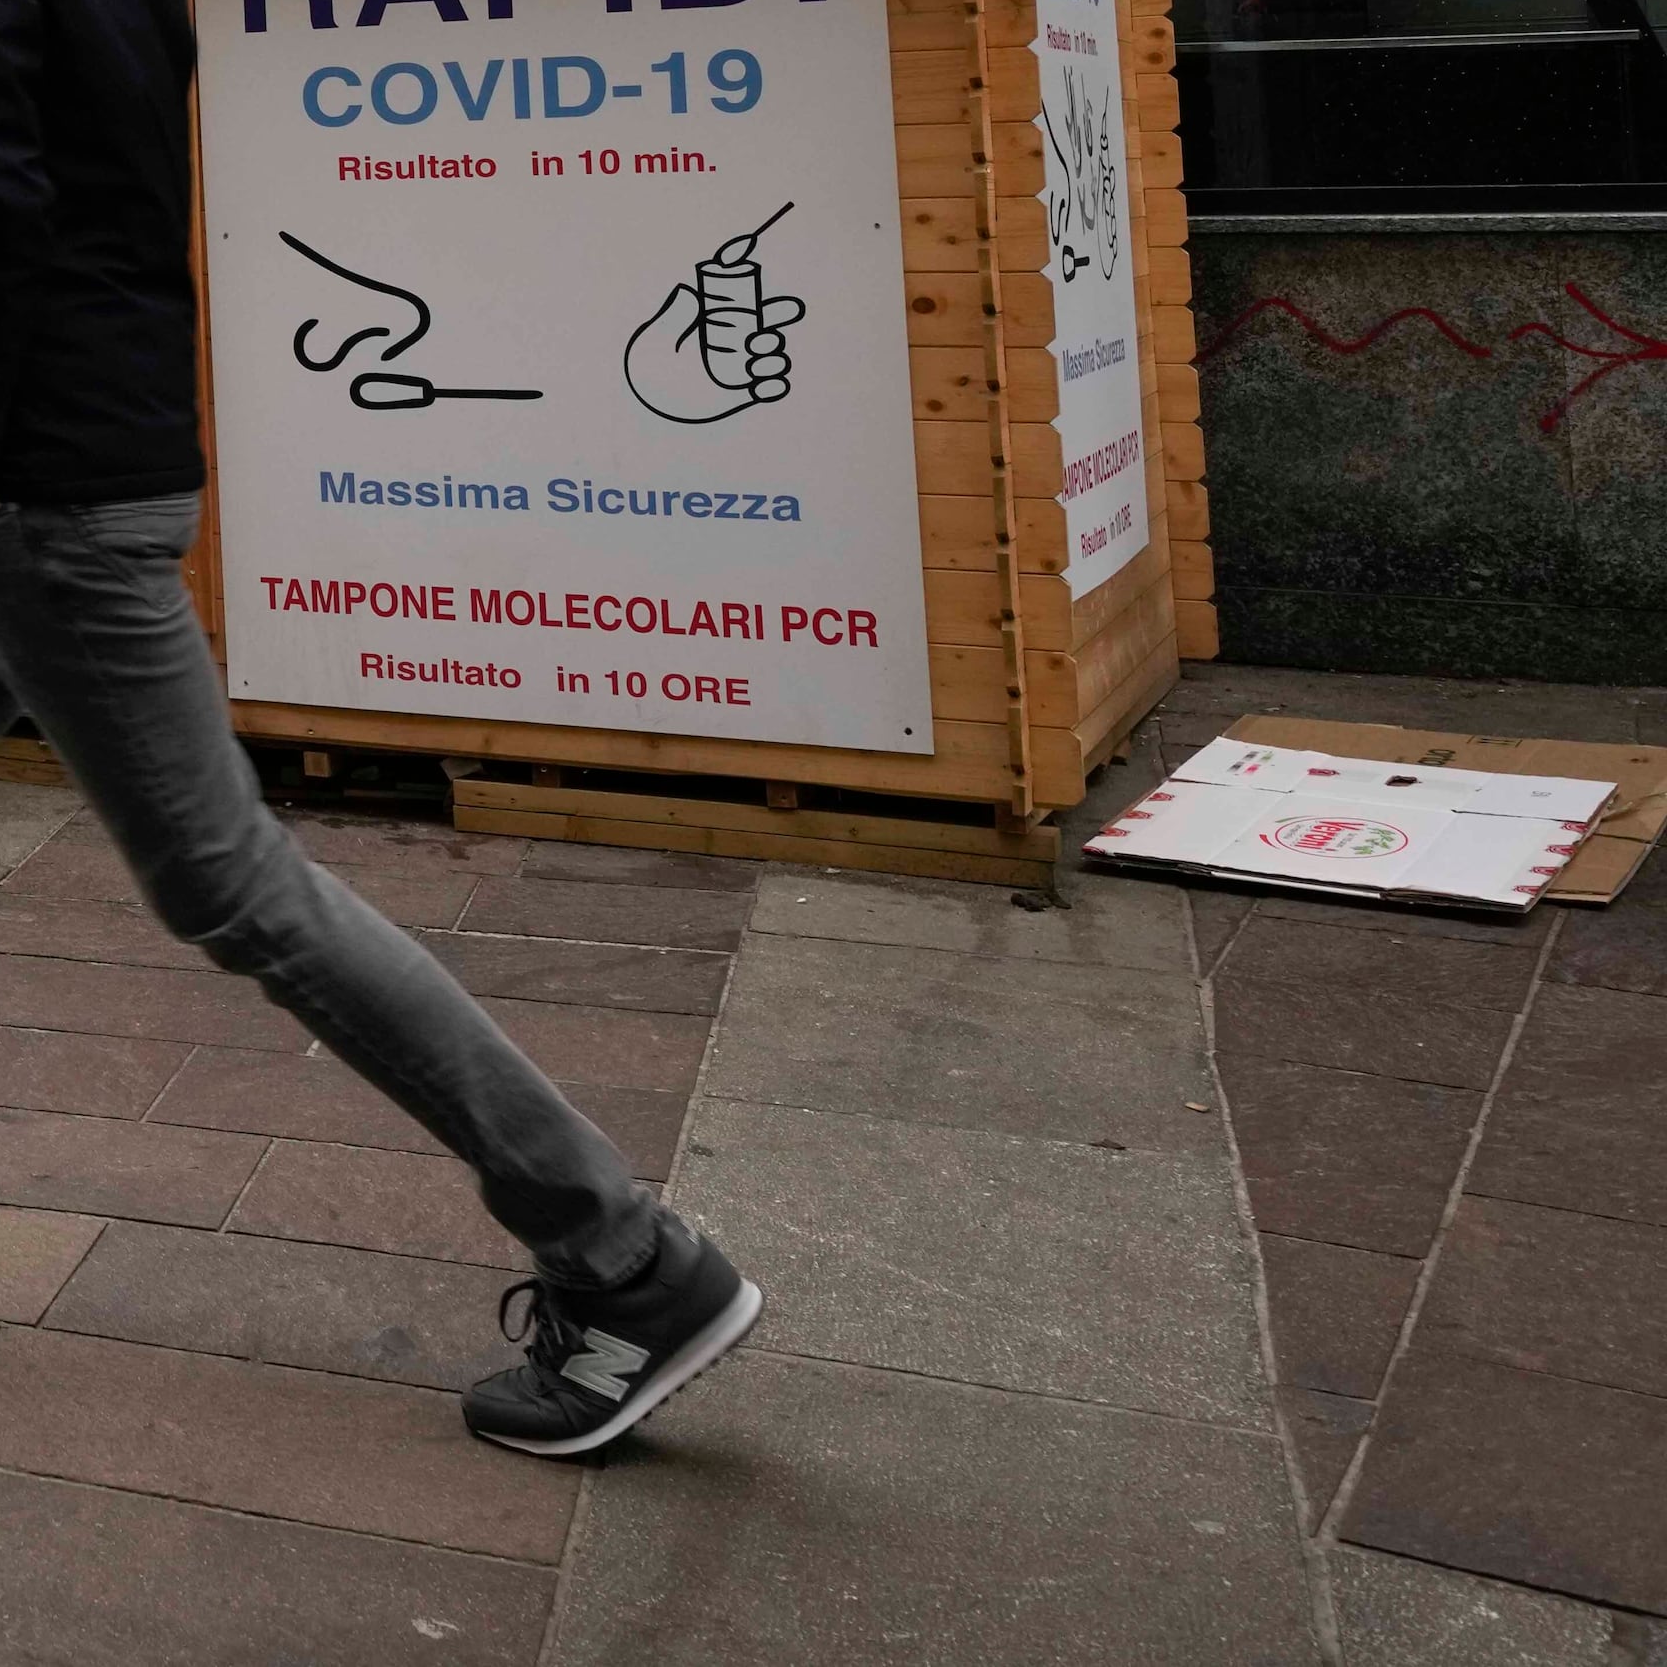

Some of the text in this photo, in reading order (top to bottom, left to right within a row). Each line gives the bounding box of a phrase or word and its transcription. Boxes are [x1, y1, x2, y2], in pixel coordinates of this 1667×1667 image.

[1047, 23, 1071, 52] Risultato
[302, 48, 763, 129] COVID-19
[338, 146, 718, 182] Risultato in 10 min.
[1062, 337, 1125, 383] Massima Sicurezza
[1092, 435, 1128, 486] MOLECOLARI
[1127, 430, 1140, 469] PCR
[320, 471, 802, 522] Massima Sicurezza
[1080, 524, 1107, 559] Risultato
[1121, 503, 1132, 533] ORE
[260, 576, 880, 648] TAMPONE MOLECOLARI PCR
[360, 652, 752, 707] Risultato in 10 ORE
[1294, 820, 1368, 852] Veroni
